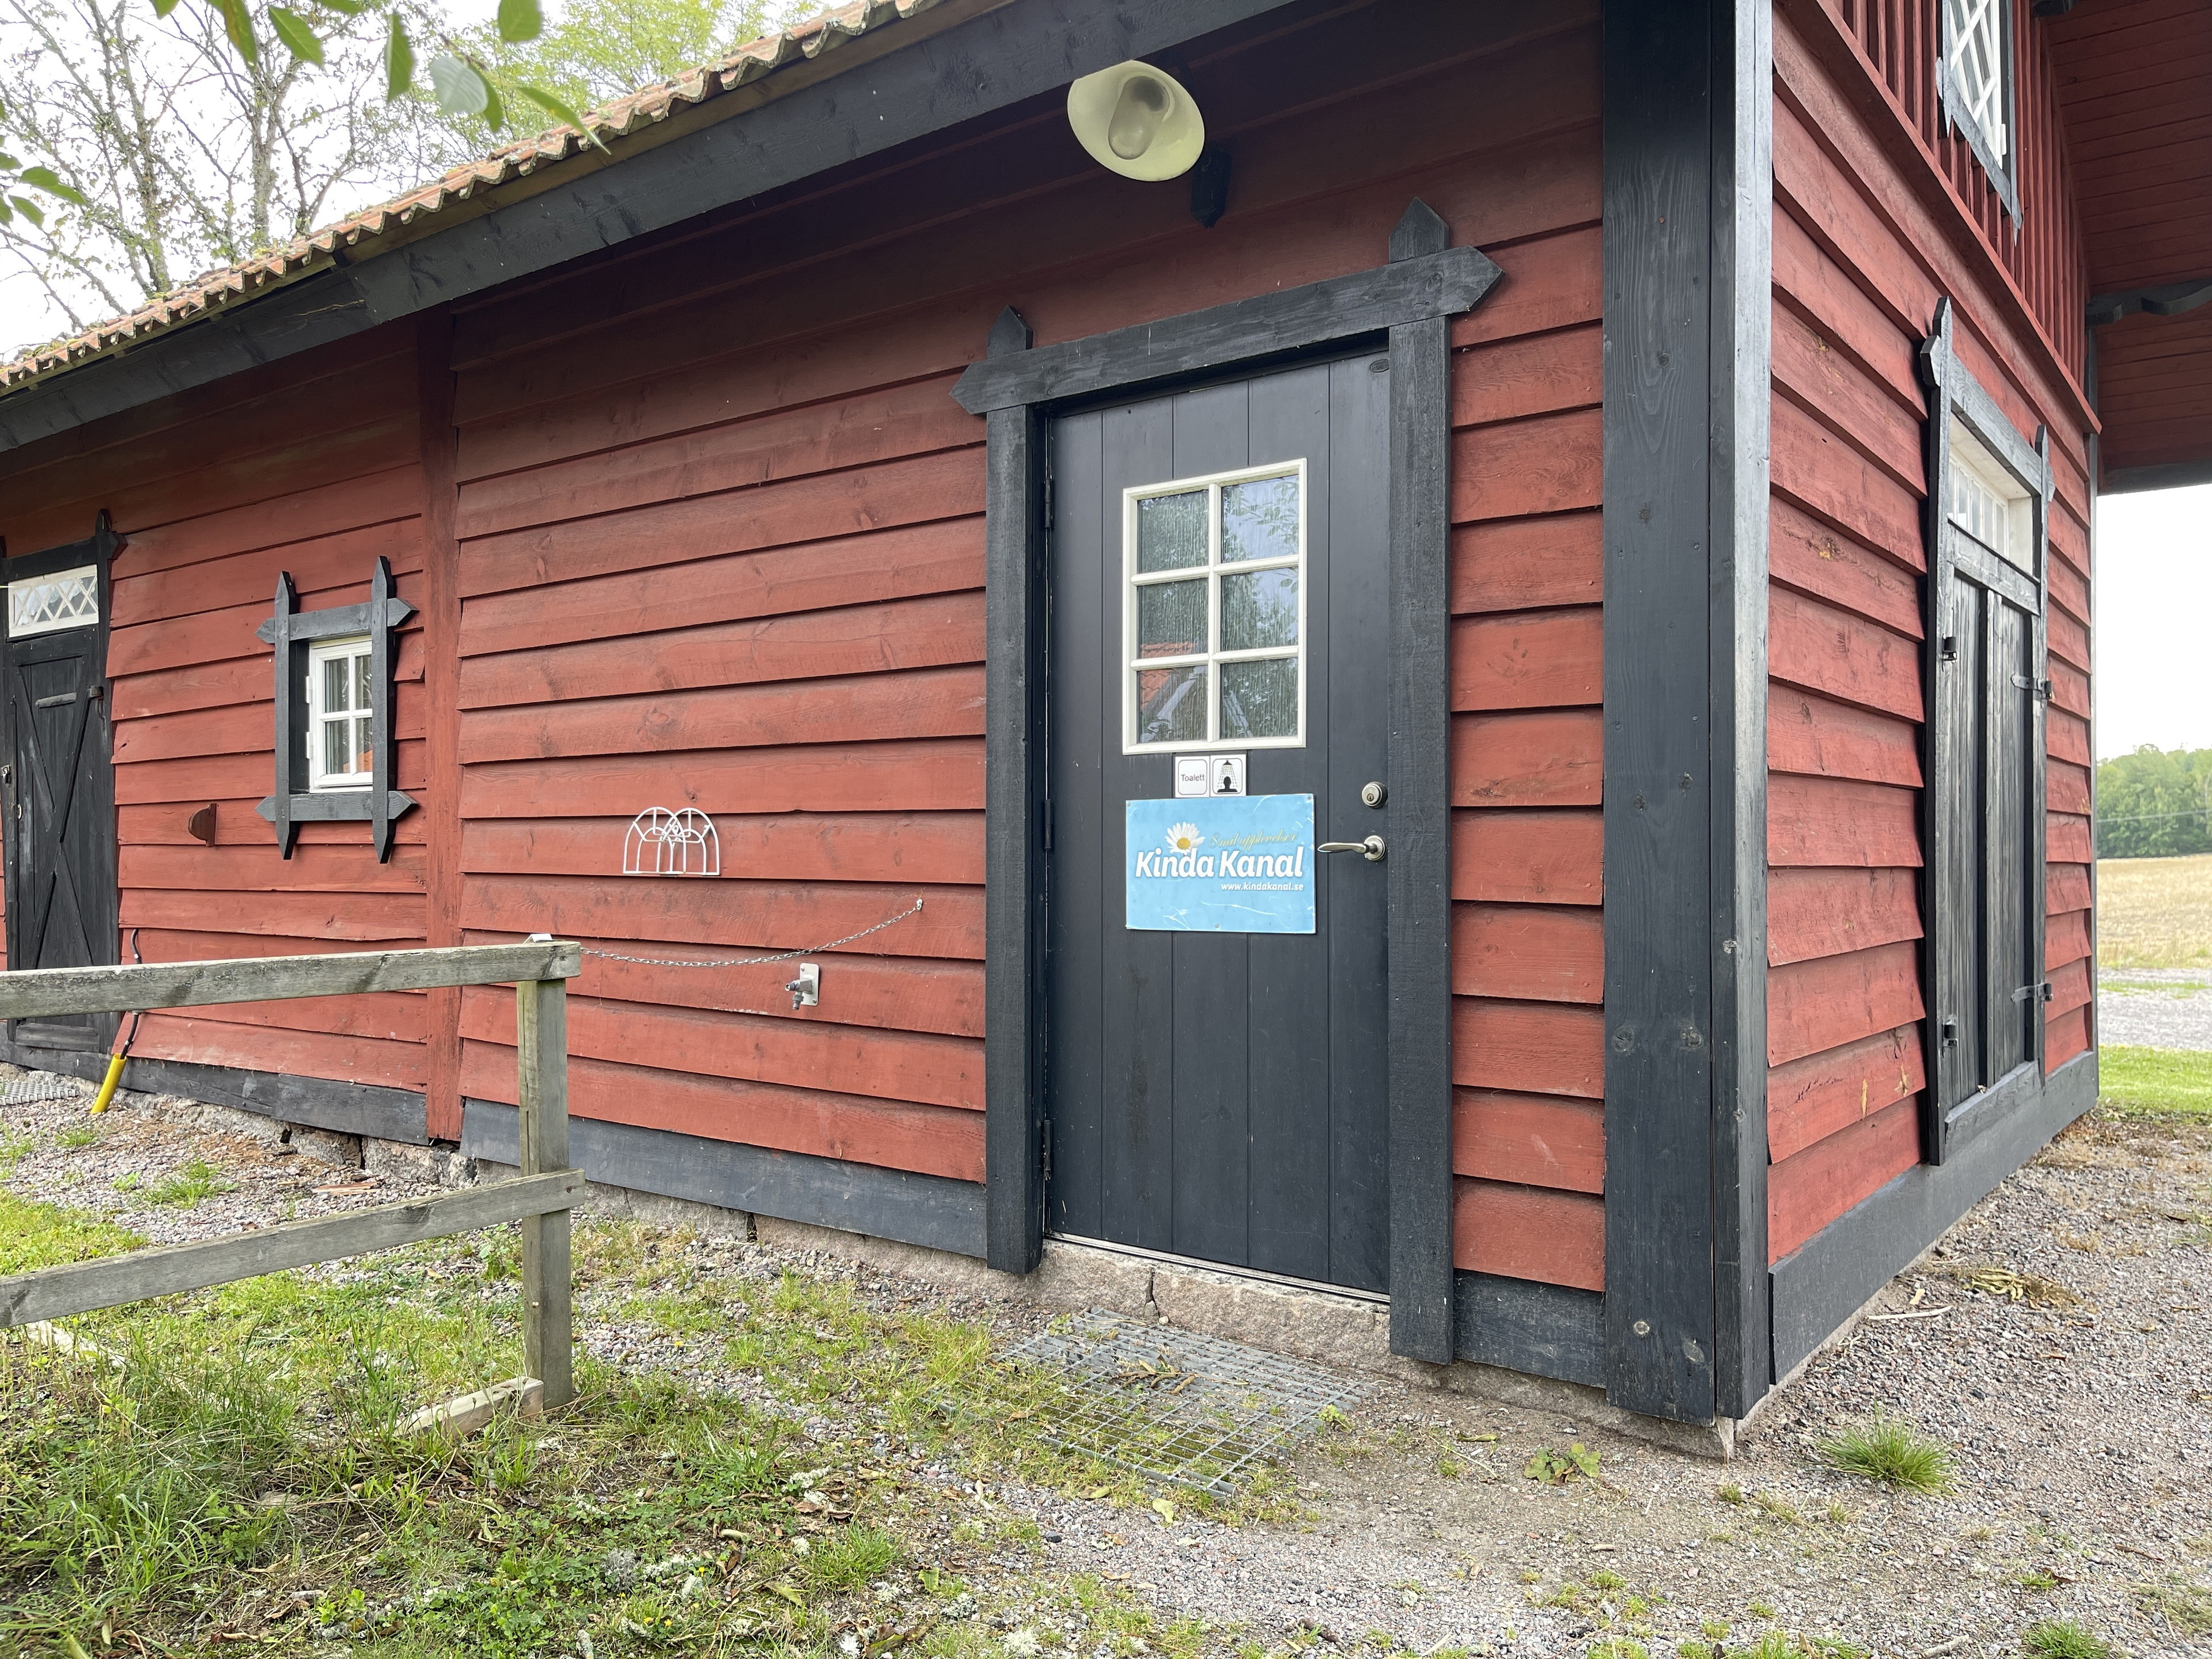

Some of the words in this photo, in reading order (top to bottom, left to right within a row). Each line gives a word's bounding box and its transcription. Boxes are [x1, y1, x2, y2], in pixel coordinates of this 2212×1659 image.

[1180, 774, 1205, 782] Toalett
[1135, 847, 1214, 878] Kinda
[1219, 846, 1304, 878] Kanal
[1221, 882, 1304, 891] www.kindakanal.se
